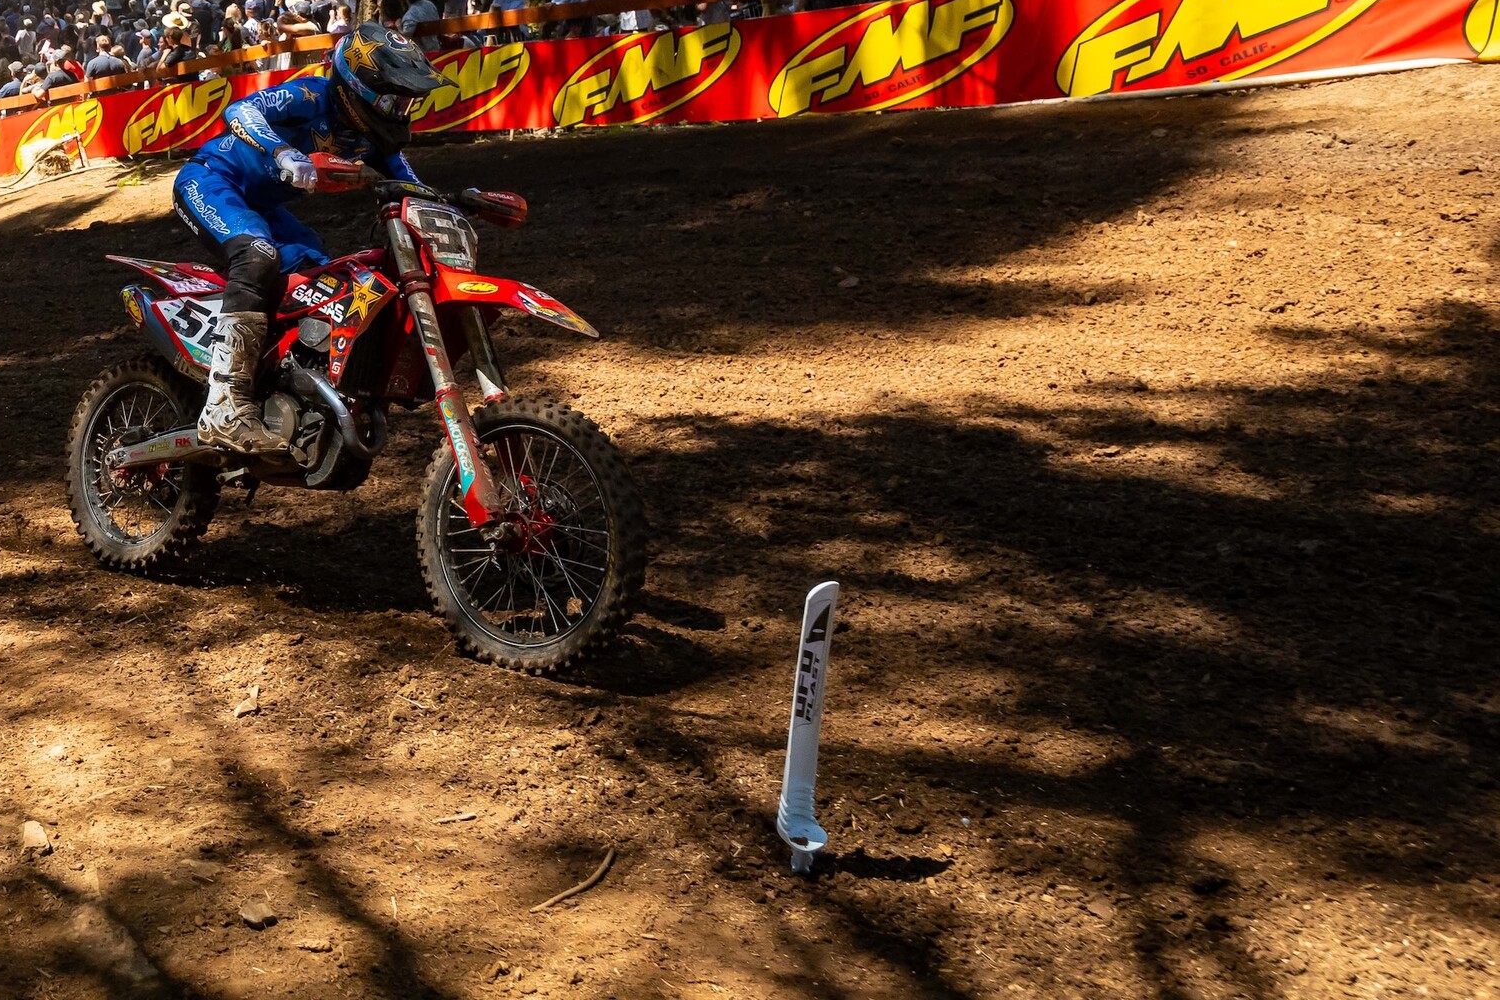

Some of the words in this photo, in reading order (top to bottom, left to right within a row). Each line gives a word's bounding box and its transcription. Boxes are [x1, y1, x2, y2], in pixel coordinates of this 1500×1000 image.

[411, 41, 524, 122] MF
[558, 21, 732, 128] FMF
[1219, 41, 1277, 68] CALIF.
[127, 77, 228, 155] FMF
[174, 202, 199, 236] ASGAS
[175, 436, 192, 448] RK
[448, 416, 475, 476] MOTOREX
[795, 649, 813, 718] UFO
[805, 653, 820, 722] PLAST
